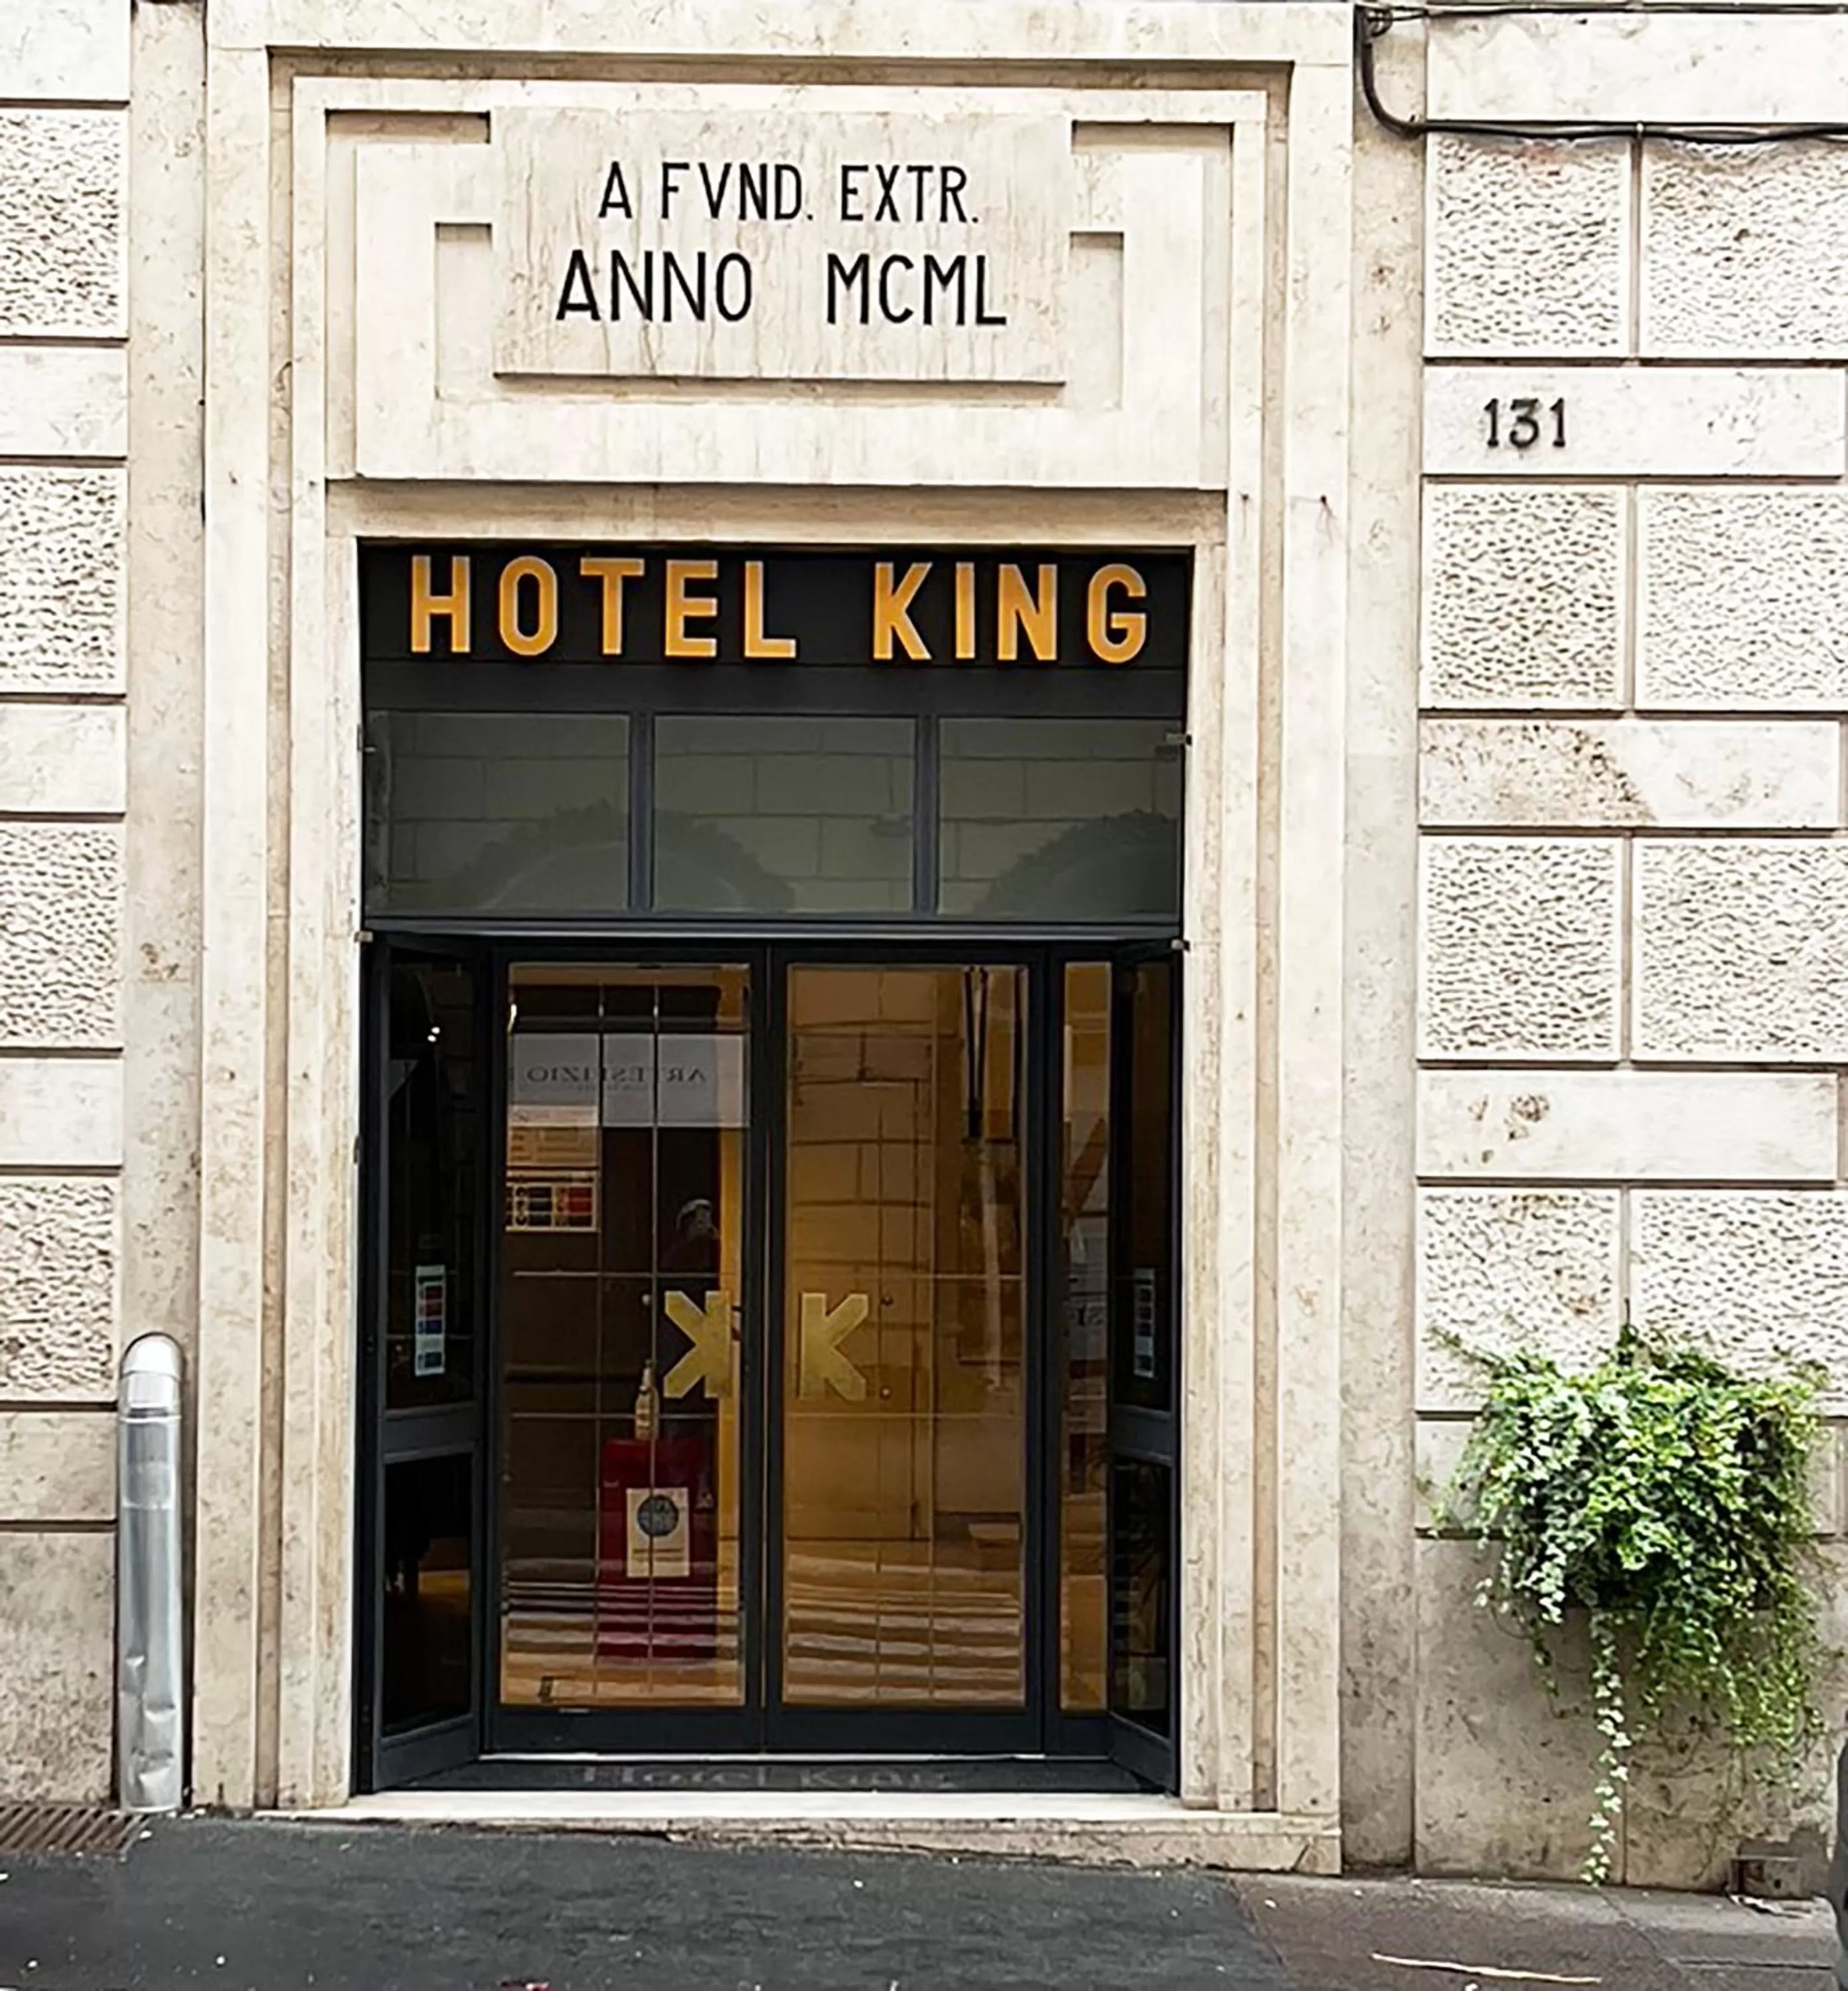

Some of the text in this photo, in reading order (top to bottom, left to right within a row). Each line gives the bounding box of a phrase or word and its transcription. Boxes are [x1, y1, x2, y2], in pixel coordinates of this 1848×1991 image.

[599, 161, 979, 223] A FVND. EXTR.
[556, 250, 1007, 325] ANNO MCML
[1484, 398, 1566, 449] 131
[410, 555, 1147, 663] HOTEL KING
[801, 1293, 868, 1400] K
